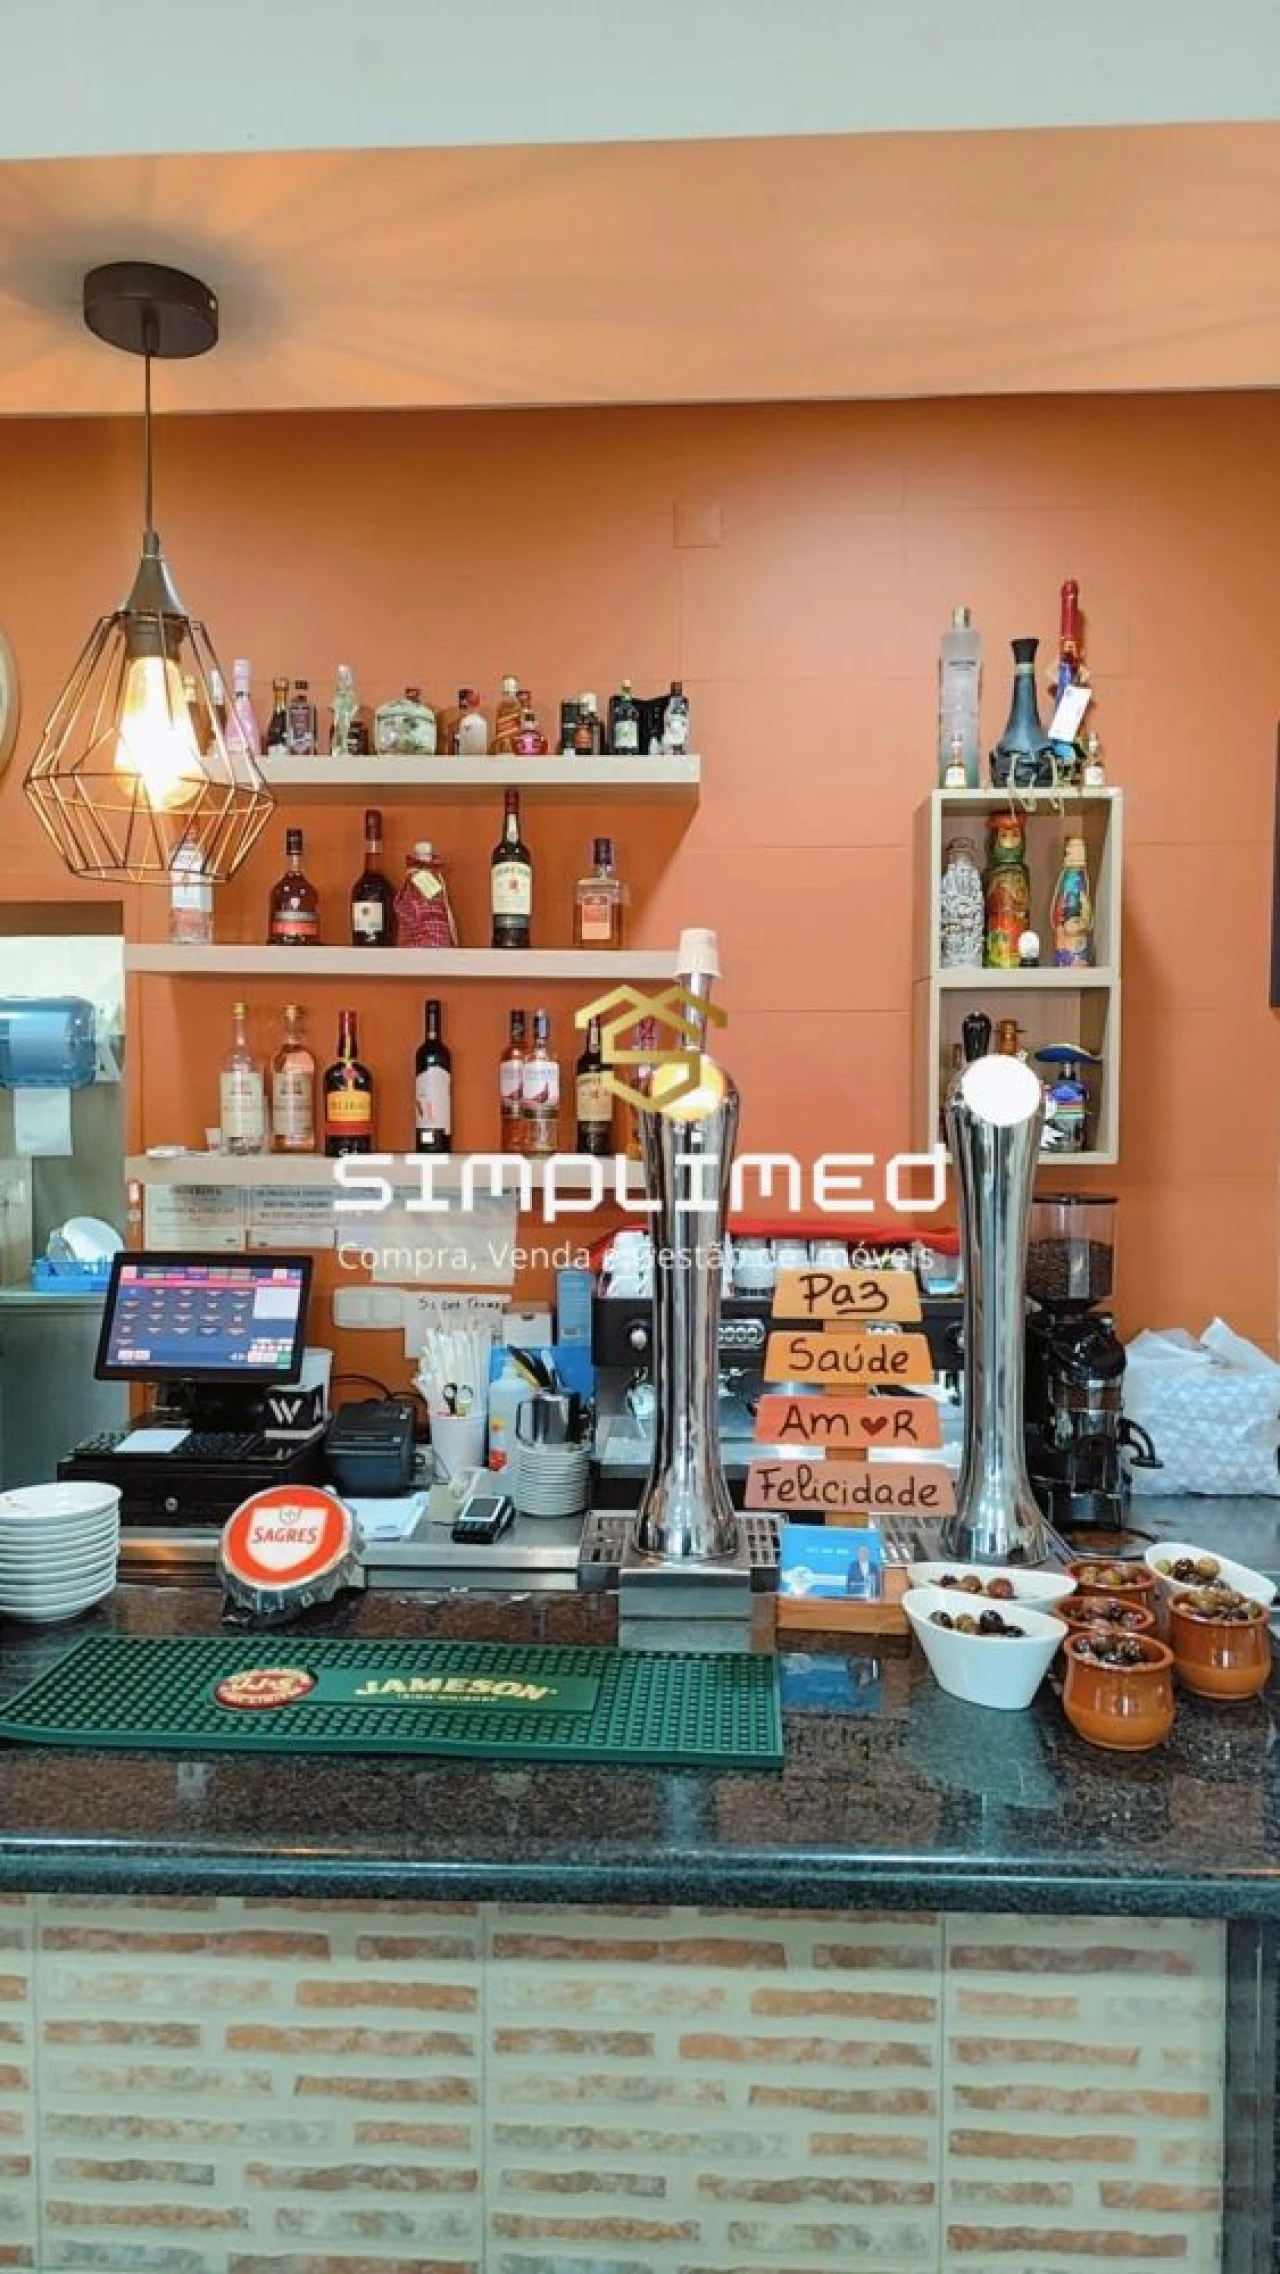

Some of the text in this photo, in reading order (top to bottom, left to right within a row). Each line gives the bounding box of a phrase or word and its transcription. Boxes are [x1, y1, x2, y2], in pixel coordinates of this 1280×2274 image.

[788, 1337, 909, 1374] Saúde
[756, 1464, 939, 1506] Felicidade
[251, 1526, 318, 1545] SAGRES
[354, 1677, 549, 1700] JAMESON
